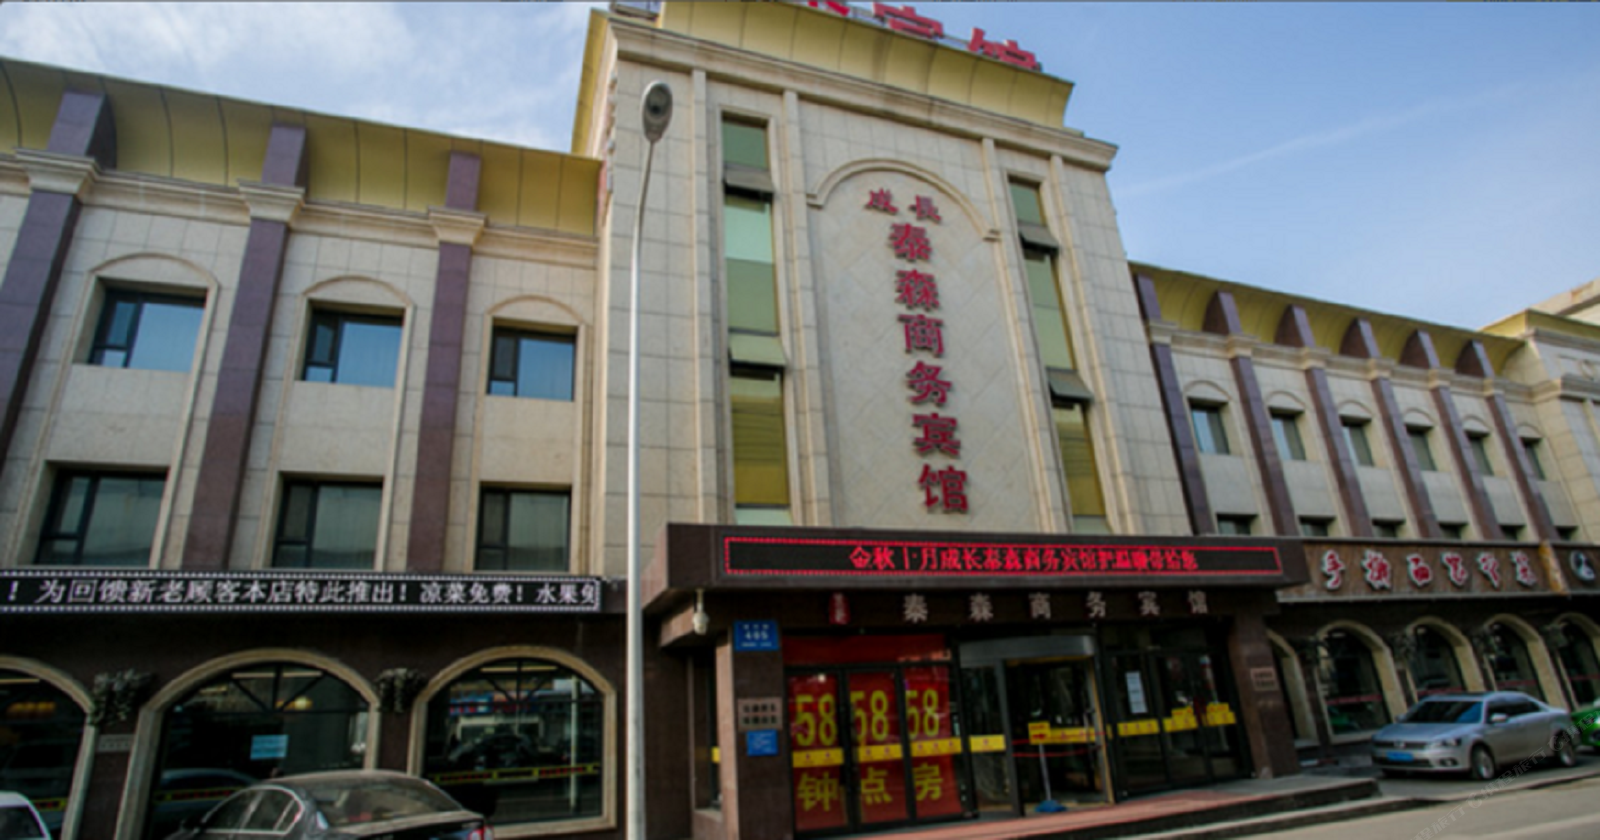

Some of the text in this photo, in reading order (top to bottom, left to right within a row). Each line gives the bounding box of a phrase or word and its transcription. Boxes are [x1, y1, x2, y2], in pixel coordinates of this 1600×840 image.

[888, 222, 970, 514] 泰森商务宾馆
[795, 693, 838, 747] 58
[849, 689, 890, 742] 58
[905, 688, 940, 739] 58
